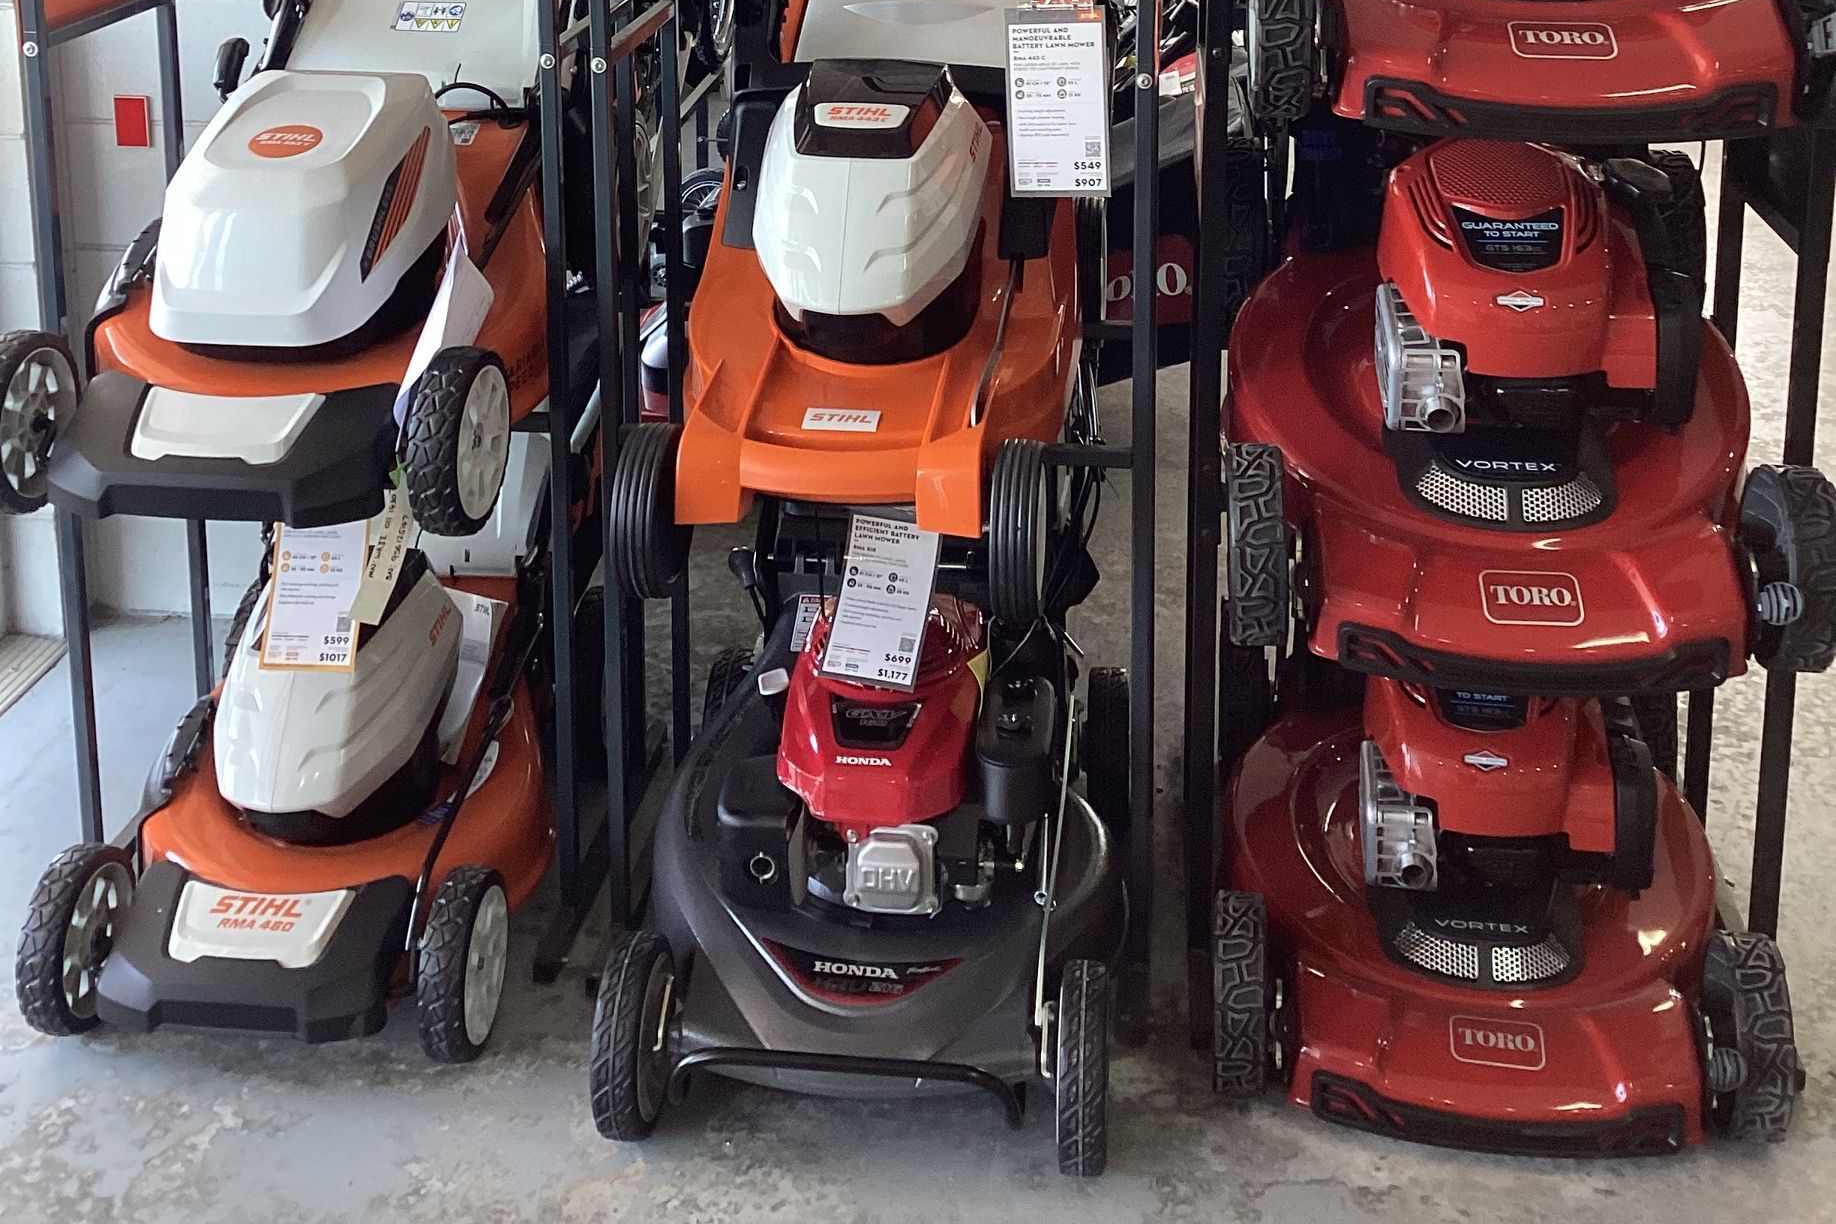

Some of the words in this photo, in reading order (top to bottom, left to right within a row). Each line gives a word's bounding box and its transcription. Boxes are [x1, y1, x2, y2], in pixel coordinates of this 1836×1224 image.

[1518, 30, 1606, 45] TORO
[827, 106, 892, 117] STIHL
[255, 133, 316, 142] STIHL
[1074, 161, 1102, 170] $549
[1075, 178, 1102, 187] $907
[1461, 221, 1560, 230] GUARANTEED
[809, 413, 872, 424] STIHL
[1455, 458, 1557, 472] VORTEX
[855, 518, 892, 529] POWERFUL
[855, 525, 889, 536] EFFICIENT
[890, 531, 920, 541] BATTERY
[875, 536, 900, 544] MOWER
[1489, 585, 1576, 607] TORO
[428, 603, 451, 647] STIHL
[323, 635, 350, 645] $599
[319, 653, 348, 662] $1017
[884, 653, 912, 665] $699
[877, 668, 908, 681] $1,177
[1456, 691, 1471, 699] TO
[1473, 693, 1507, 702] START
[835, 755, 892, 767] HONDA
[860, 867, 913, 890] OHV
[208, 895, 303, 918] STIHL
[216, 917, 257, 930] RMA
[1434, 918, 1529, 934] VORTEX
[812, 960, 899, 980] HONDA
[1458, 1027, 1537, 1052] TORO
